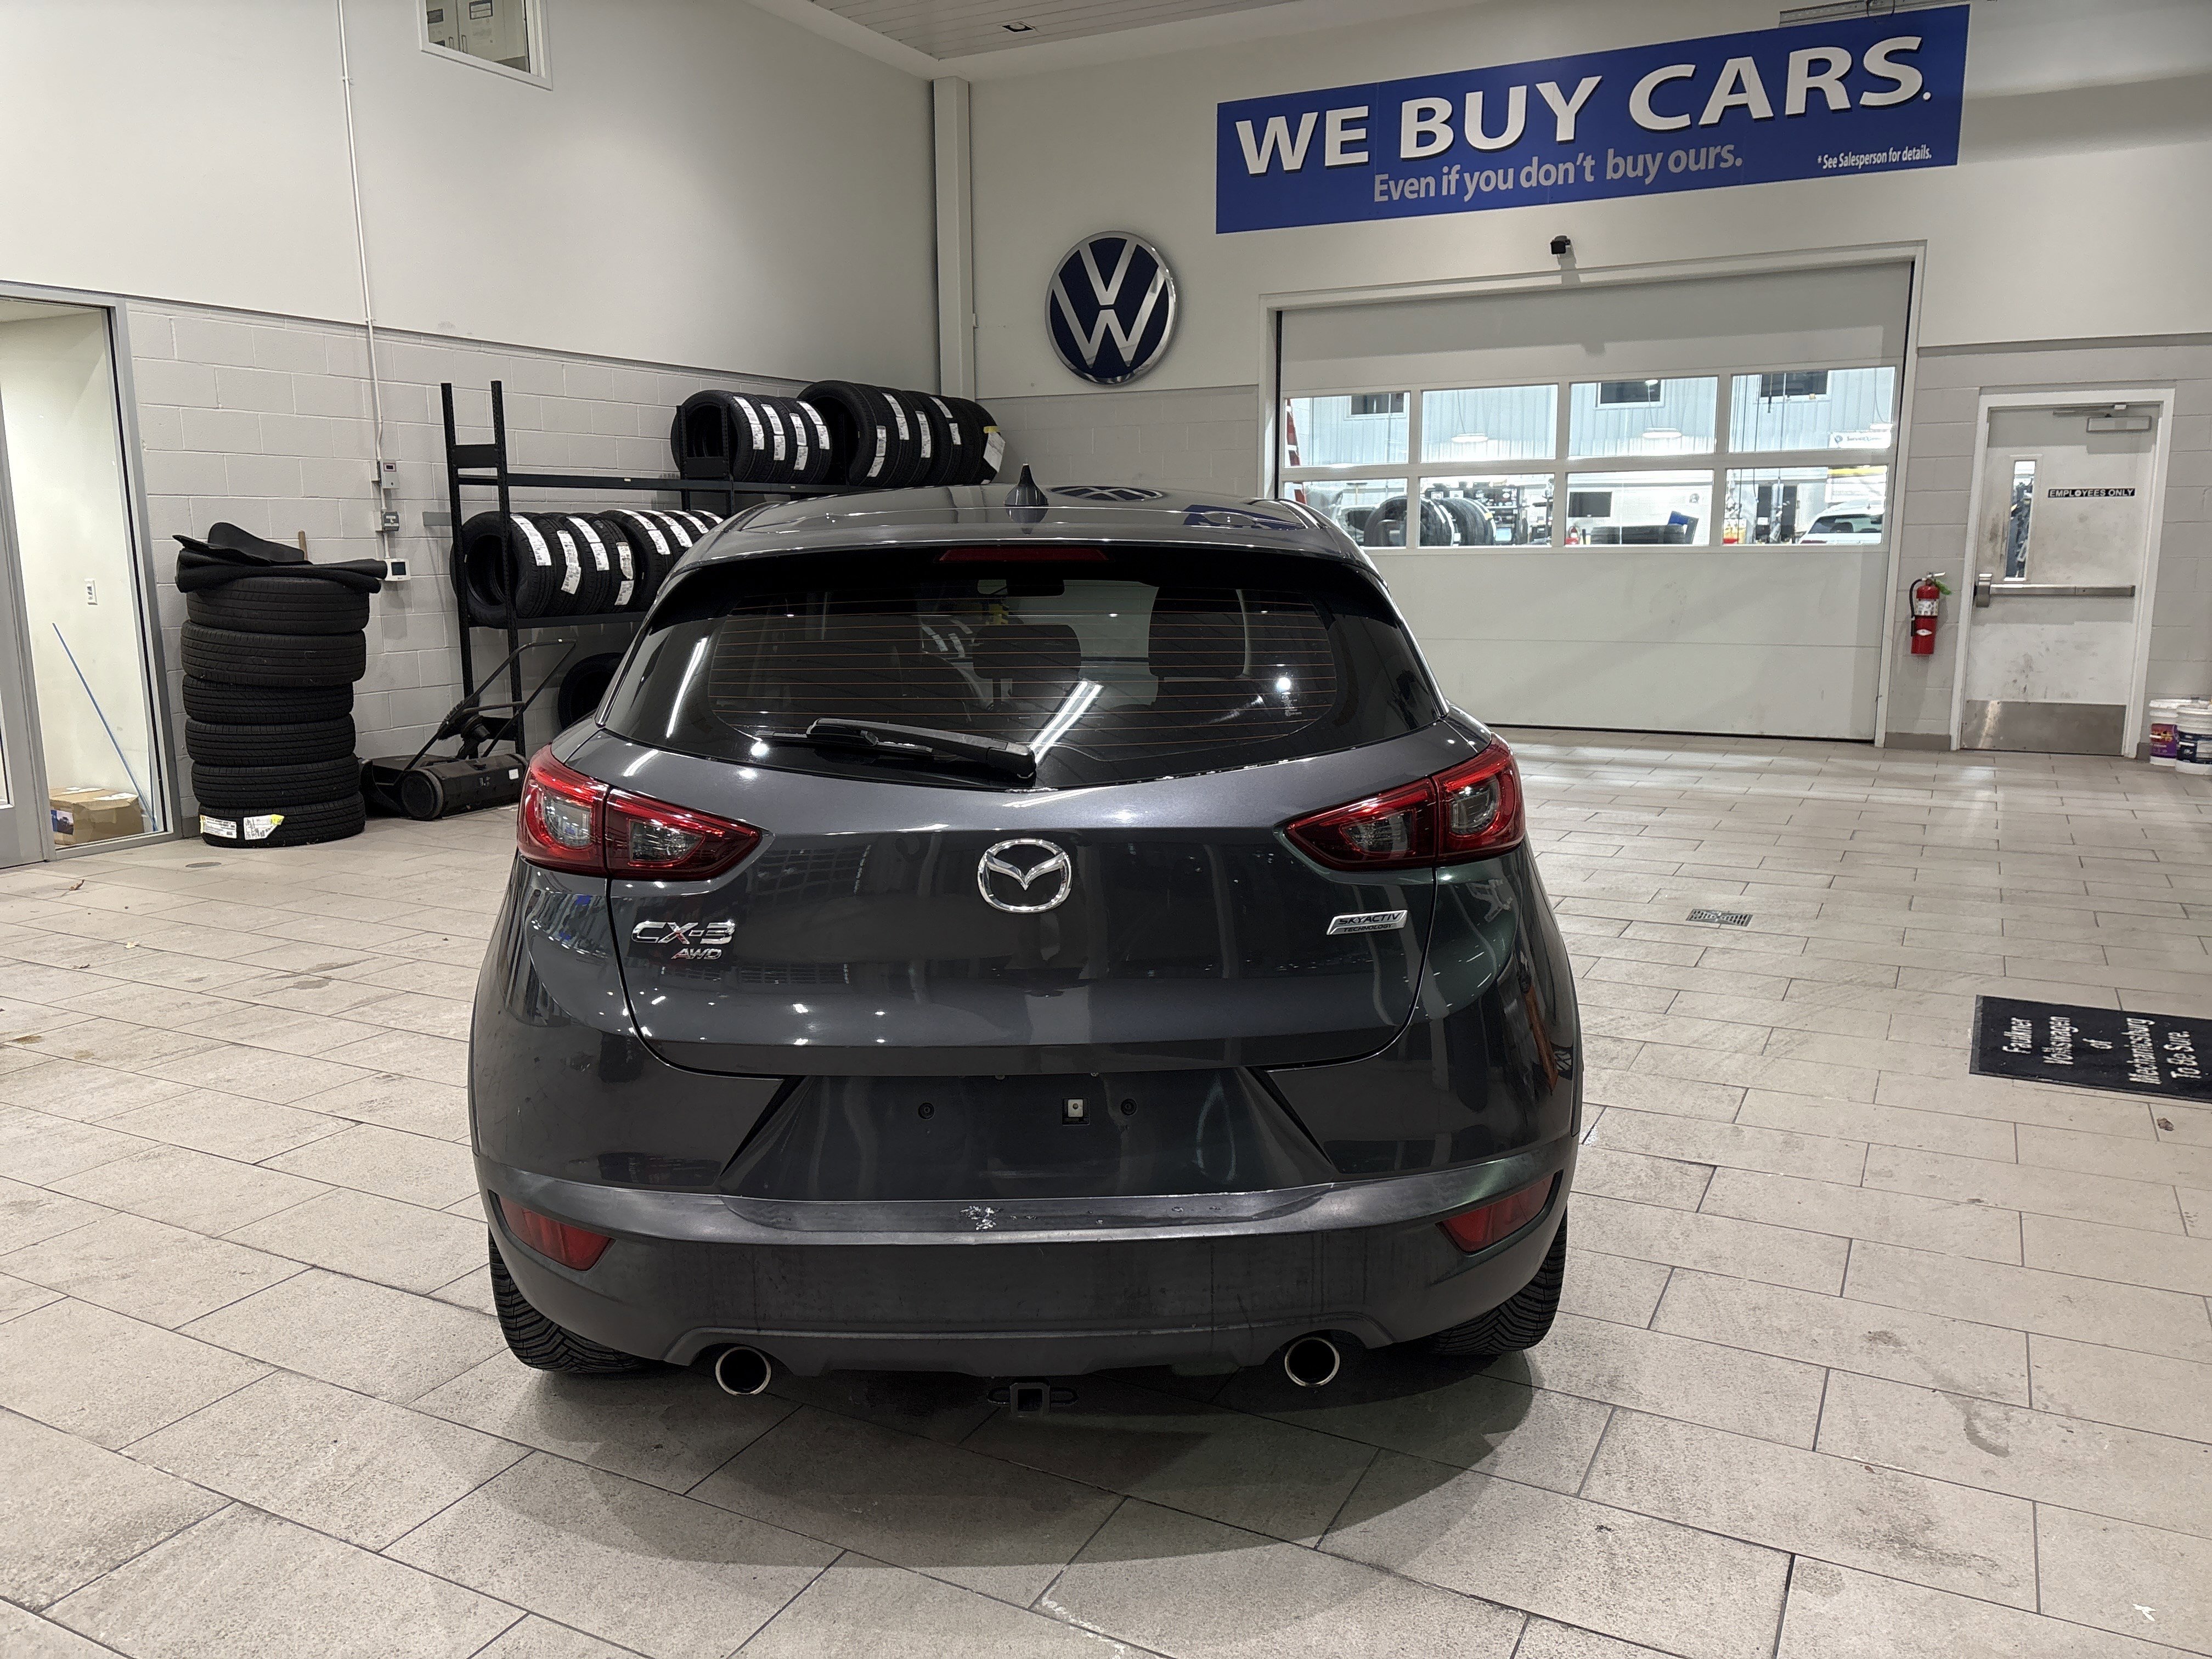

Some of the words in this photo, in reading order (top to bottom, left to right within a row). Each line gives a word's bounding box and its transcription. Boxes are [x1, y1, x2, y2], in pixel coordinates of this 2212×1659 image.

[1235, 105, 1369, 174] WE
[1400, 76, 1603, 160] BUY
[1628, 36, 1932, 131] CARS.
[1838, 151, 1888, 170] Salesperson
[1888, 147, 1902, 163] for
[1901, 144, 1933, 161] details.
[1374, 173, 1436, 202] Even
[1441, 164, 1461, 196] if
[1463, 167, 1515, 202] you
[1519, 152, 1596, 188] don't
[1606, 148, 1664, 186] buy
[1667, 144, 1743, 174] ours.
[1338, 913, 1401, 924] SKYACTIV
[631, 921, 736, 945] CX-3
[670, 947, 722, 960] AWD
[2002, 1017, 2033, 1054] Faulkner
[2041, 1015, 2079, 1065] Volkswagen
[2082, 1037, 2113, 1049] of
[2121, 1017, 2163, 1085] Mechanicsburg
[2166, 1053, 2198, 1066] Be
[2170, 1067, 2203, 1079] To
